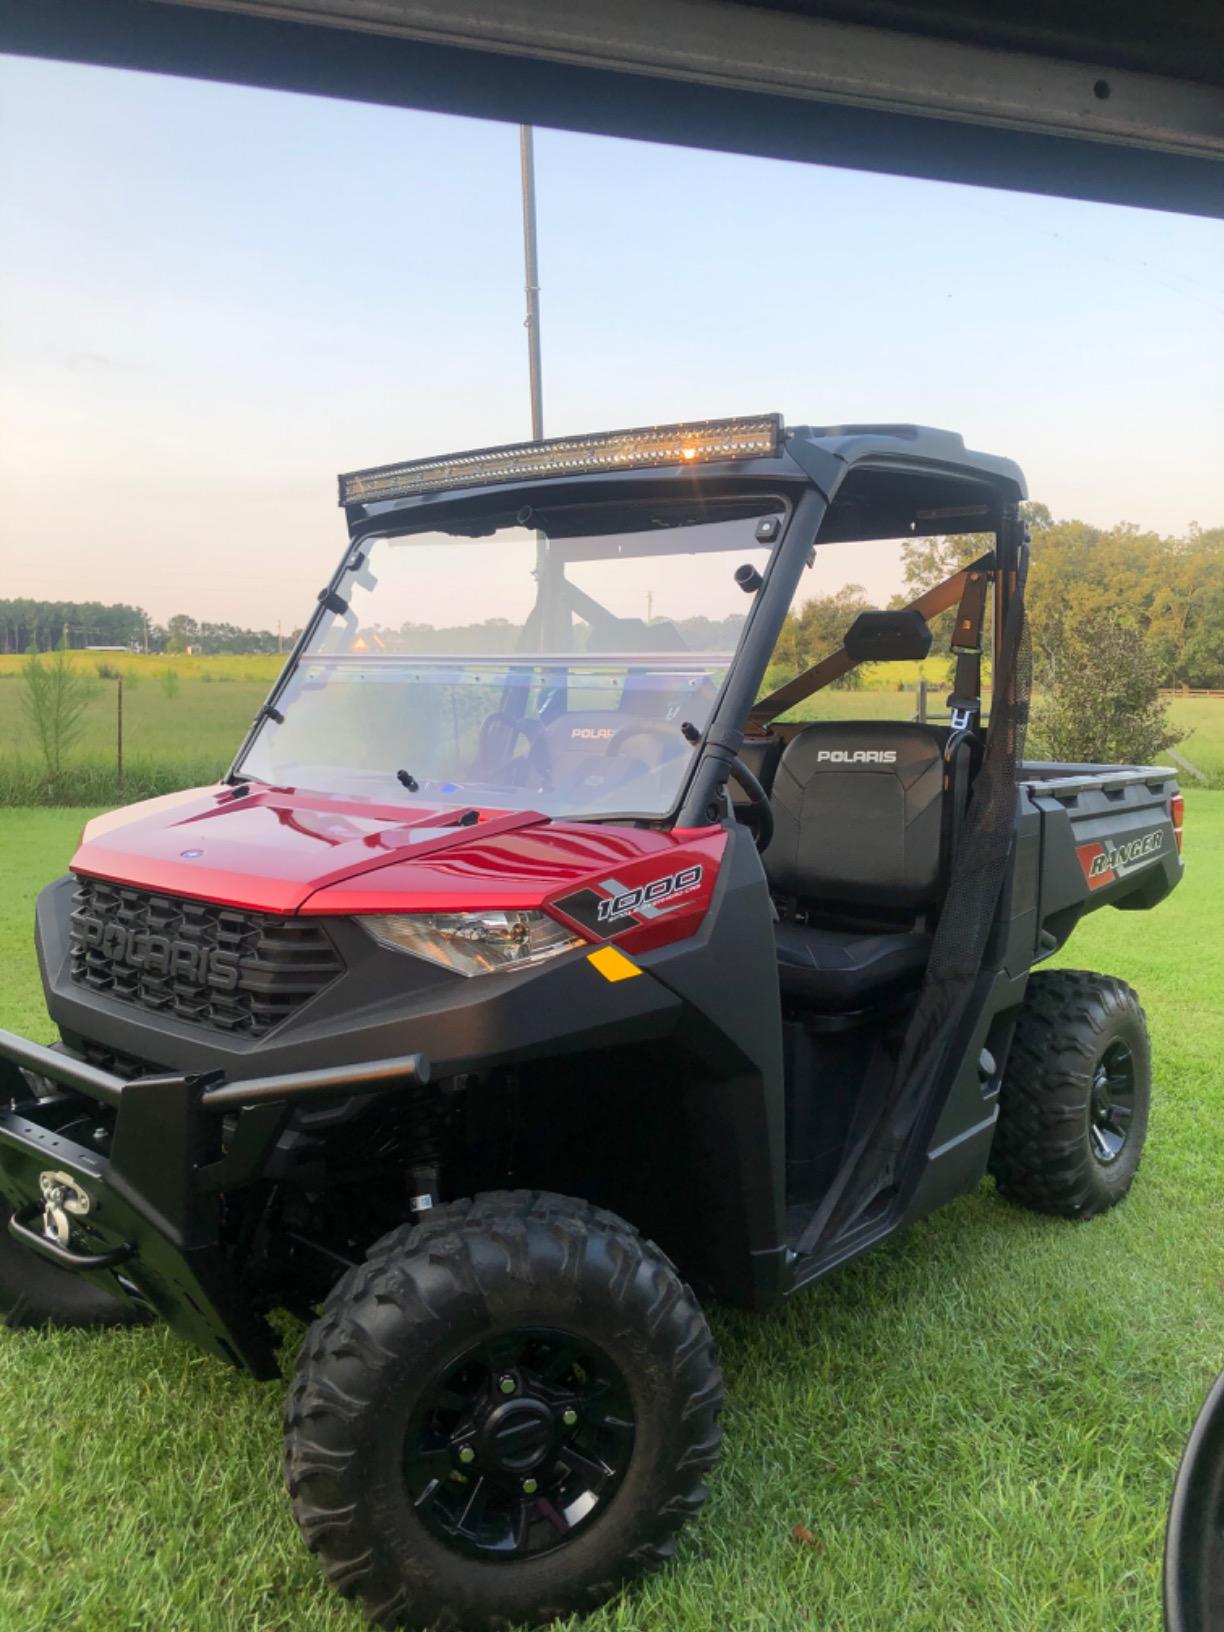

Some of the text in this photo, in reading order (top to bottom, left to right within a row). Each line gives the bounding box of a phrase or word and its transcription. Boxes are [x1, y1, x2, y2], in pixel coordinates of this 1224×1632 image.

[571, 728, 617, 739] POLAR
[817, 751, 897, 763] POLARIS
[1088, 829, 1164, 878] RANGER
[597, 864, 703, 922] 1000
[80, 915, 240, 990] POLARIS
